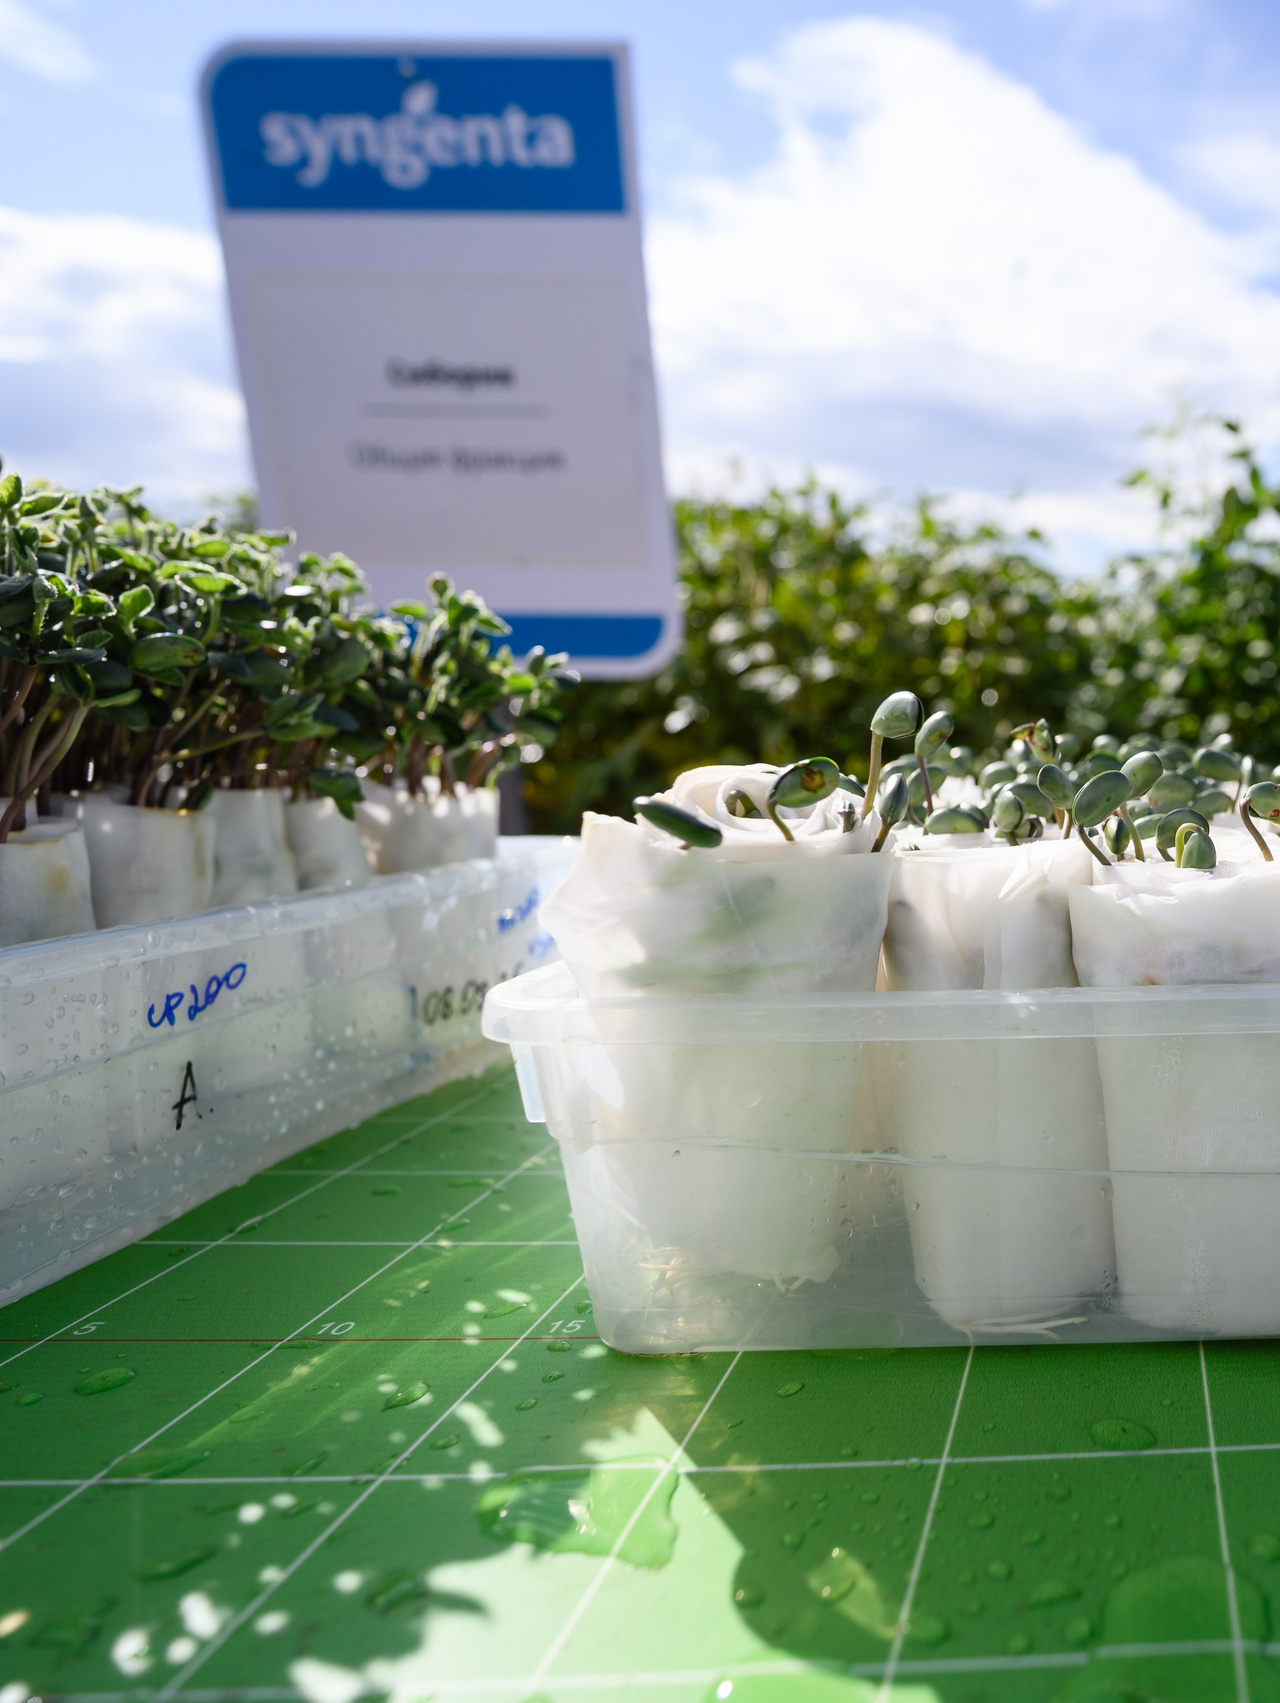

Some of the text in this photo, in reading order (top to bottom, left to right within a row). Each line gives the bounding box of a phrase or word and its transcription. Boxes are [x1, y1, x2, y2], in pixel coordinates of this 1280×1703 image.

[260, 102, 575, 188] syngenta
[73, 1321, 104, 1336] 5
[315, 1320, 357, 1336] 10
[549, 1319, 586, 1334] 15
